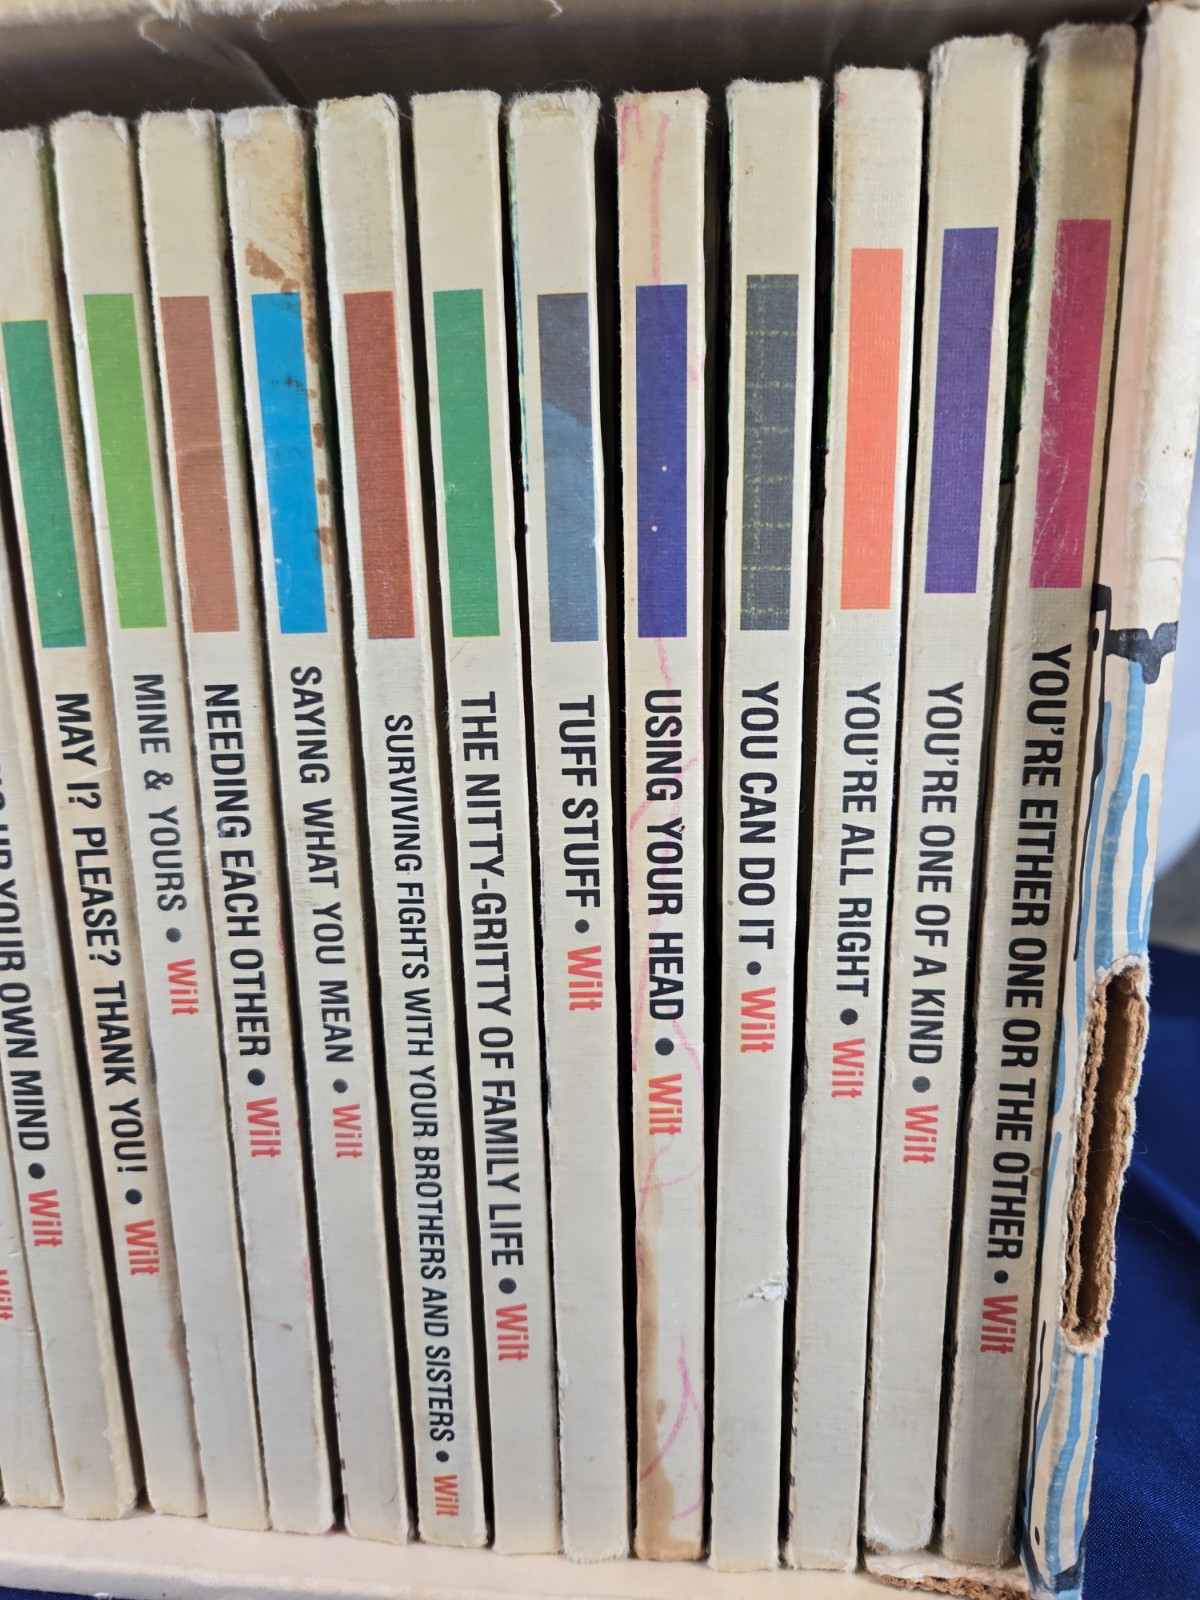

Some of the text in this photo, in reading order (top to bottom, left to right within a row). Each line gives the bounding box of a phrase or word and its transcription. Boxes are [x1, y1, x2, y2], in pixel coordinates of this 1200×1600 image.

[0, 982, 39, 1058] OWN
[55, 693, 160, 1275] MAY I? PLEASE? THANK YOU! Wilt
[133, 674, 199, 1015] MINE & YOURS Wilt
[204, 683, 281, 1157] NEEDING EACH OTHER Wilt
[290, 666, 362, 1158] SAYING WHAT YOU MEAN Wilt
[461, 691, 529, 1361] THE NITTY-GRITTY OF FAMILY LIFE Wilt
[558, 694, 604, 1011] TUFF STUFF Wilt
[644, 689, 684, 1136] USING YOUR HEAD Wilt
[738, 680, 779, 1053] YOU CAN DO IT Wilt
[830, 681, 881, 1099] YOU'RE ALL RIGHT Wilt
[902, 681, 964, 1164] YOU'RE ONE OF A KIND Wilt
[980, 643, 1073, 1353] YOU'RE EITHER ONE OR THE OTHER Wilt
[9, 1070, 50, 1151] MIND
[27, 1189, 62, 1246] Wilt
[384, 714, 458, 1516] SURVIVING FIGHTS WITH YOUR BROTHERS AND SISTERS Wilt
